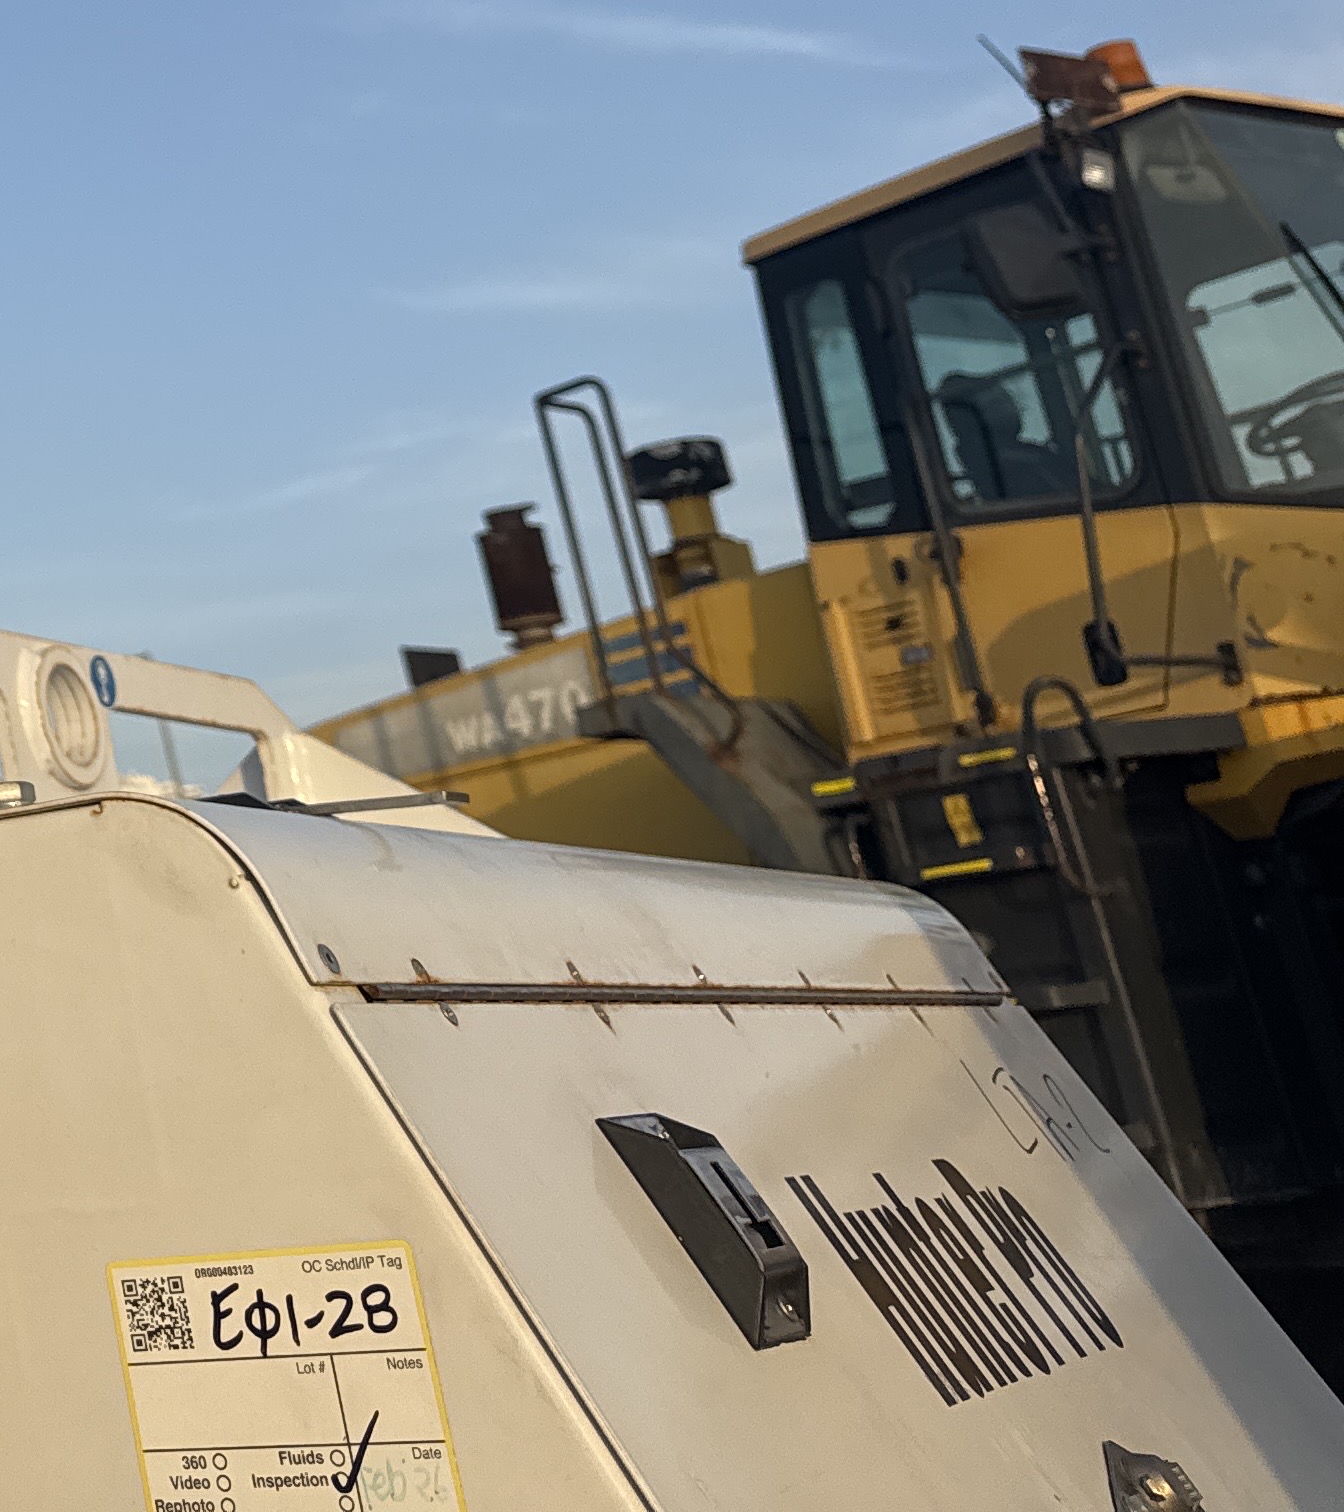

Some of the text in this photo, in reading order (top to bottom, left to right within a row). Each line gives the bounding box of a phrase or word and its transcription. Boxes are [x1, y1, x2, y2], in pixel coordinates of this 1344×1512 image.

[301, 1260, 323, 1274] OC
[377, 1254, 403, 1270] Tag
[785, 1158, 1124, 1407] Hunter Pro
[296, 1360, 326, 1375] Lot #
[386, 1355, 424, 1371] Notes
[278, 1450, 325, 1466] Fluids
[411, 1446, 443, 1460] Date
[182, 1455, 208, 1470] 360
[169, 1475, 211, 1491] Video
[251, 1474, 330, 1492] Inspection
[155, 1499, 215, 1512] Rephoto
